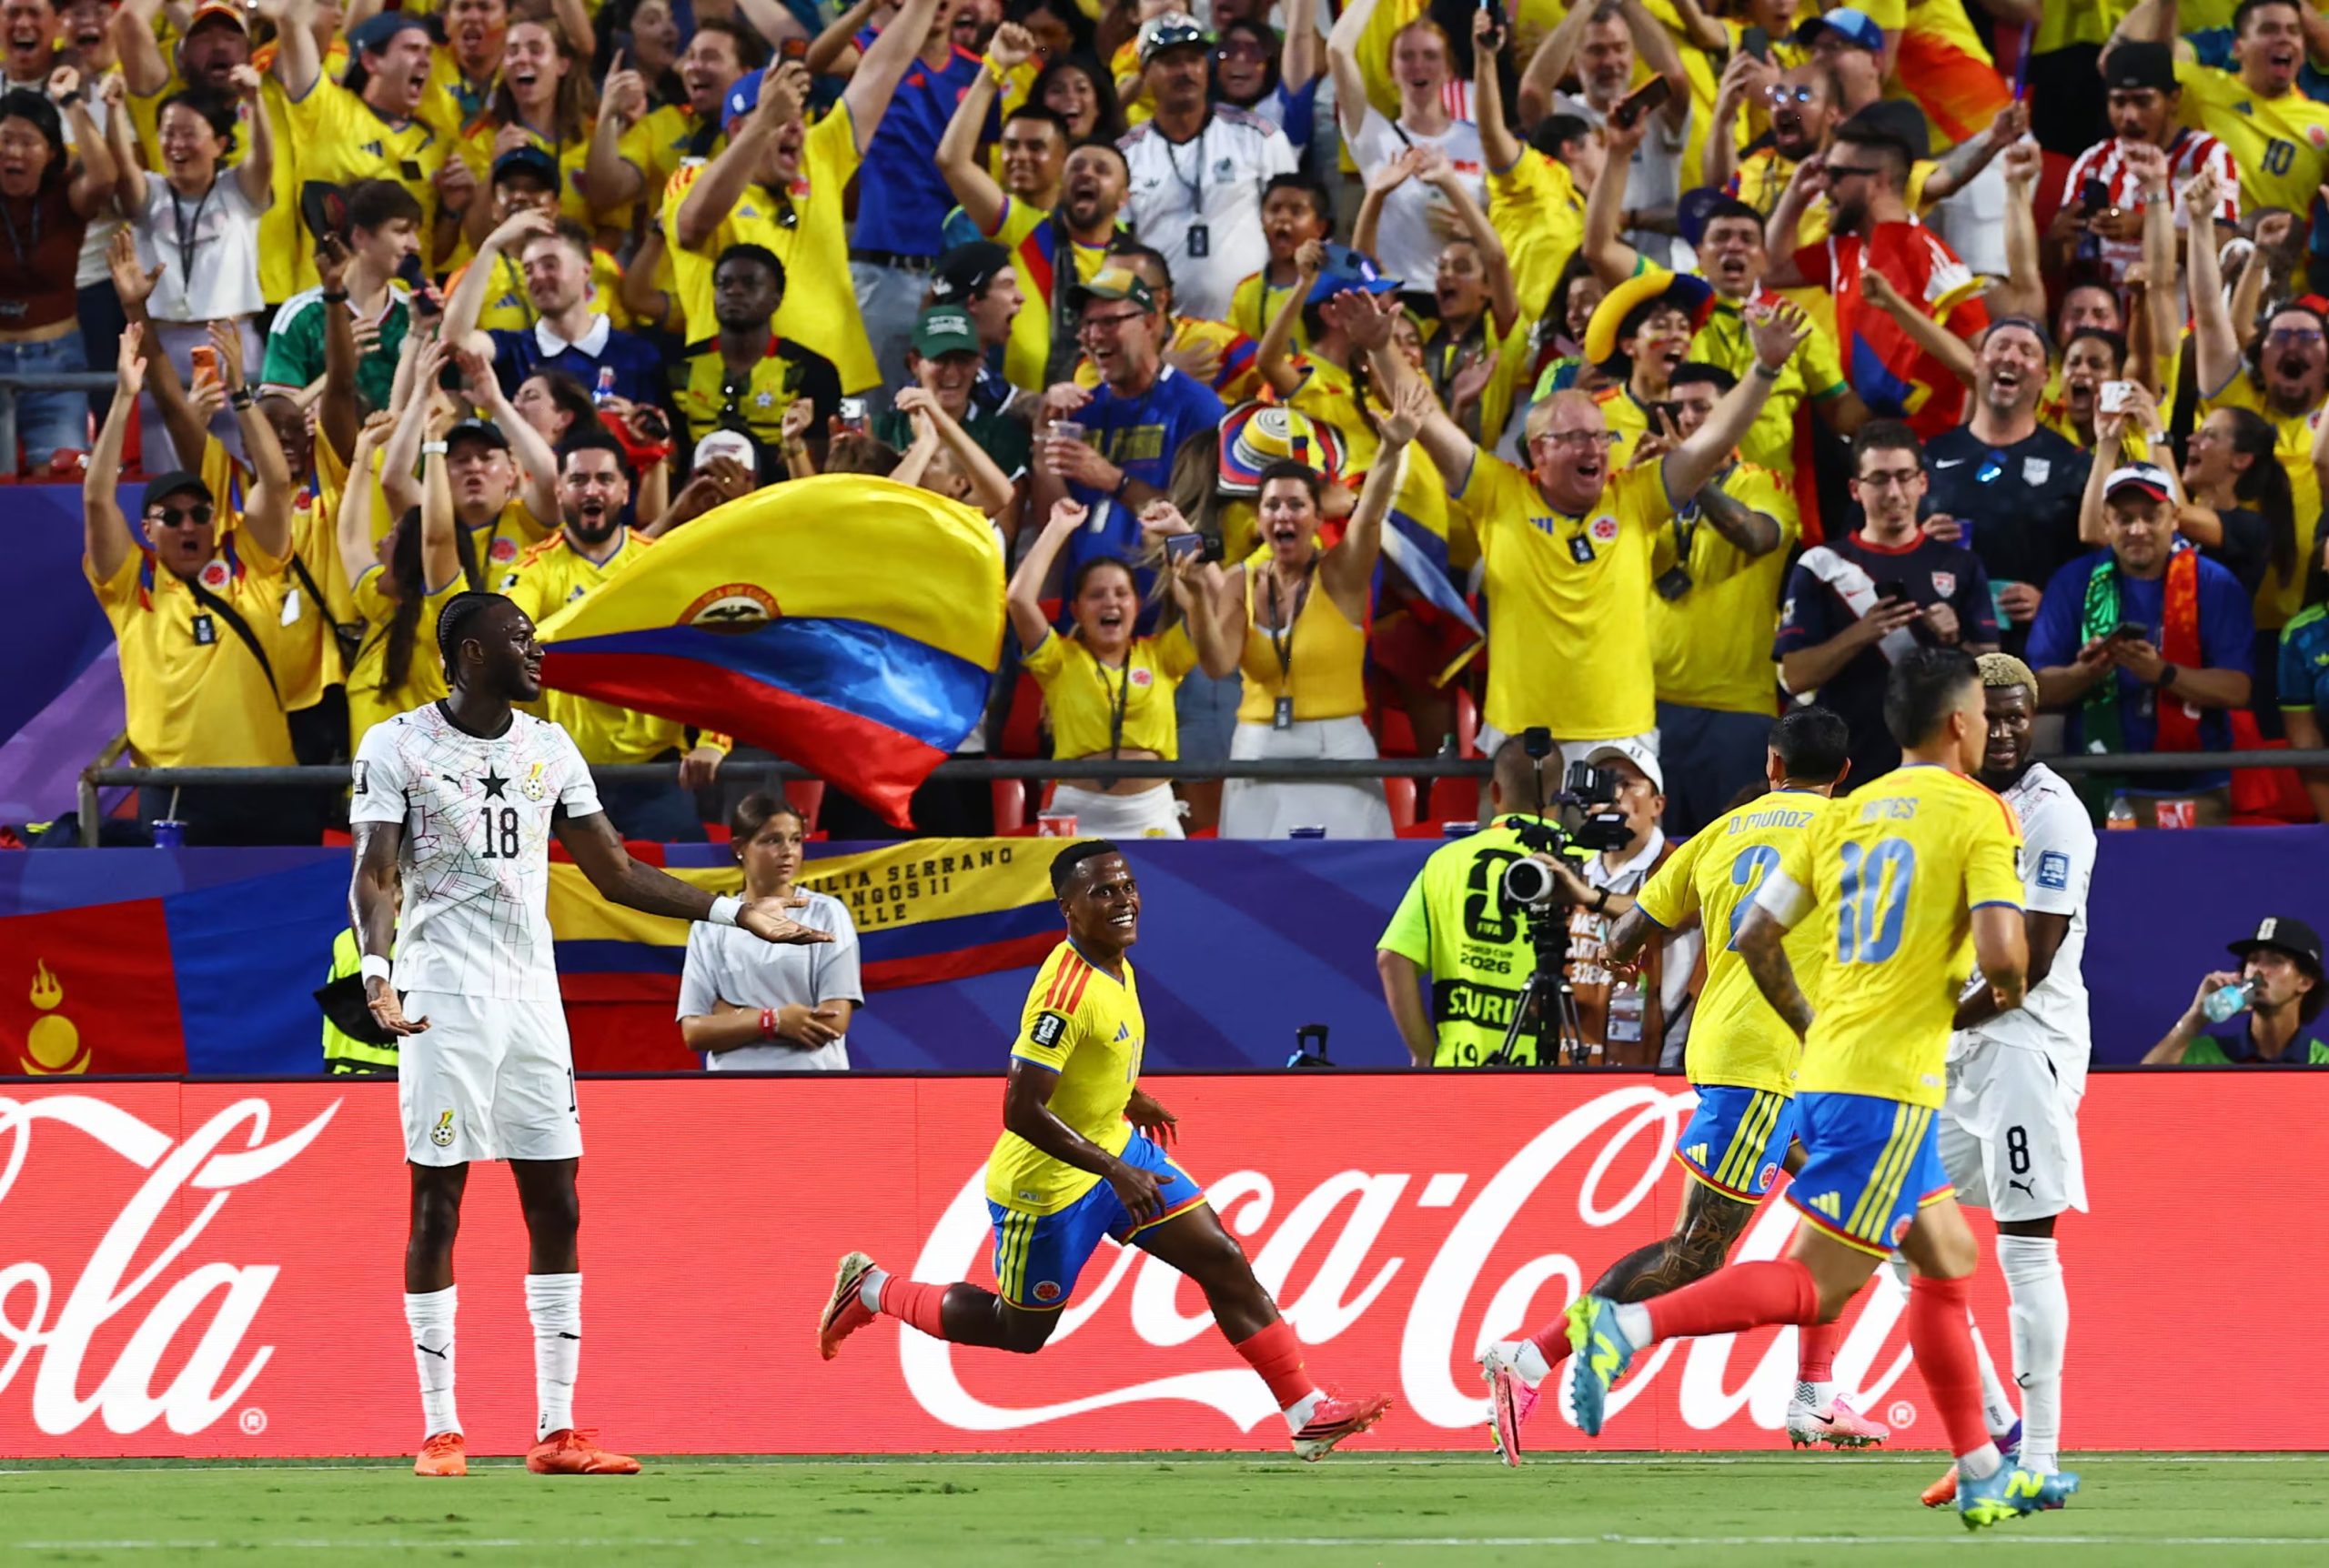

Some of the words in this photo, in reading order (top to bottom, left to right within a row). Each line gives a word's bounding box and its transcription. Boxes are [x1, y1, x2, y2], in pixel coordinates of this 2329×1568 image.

[2260, 137, 2295, 176] 10
[481, 807, 519, 859] 18
[1729, 808, 1814, 835] D.MUÑOZ
[887, 847, 1012, 881] SERRANO
[1726, 845, 1781, 951] 2
[1838, 838, 1916, 964] 10
[1459, 951, 1511, 975] 2026
[2006, 1124, 2031, 1175] 8
